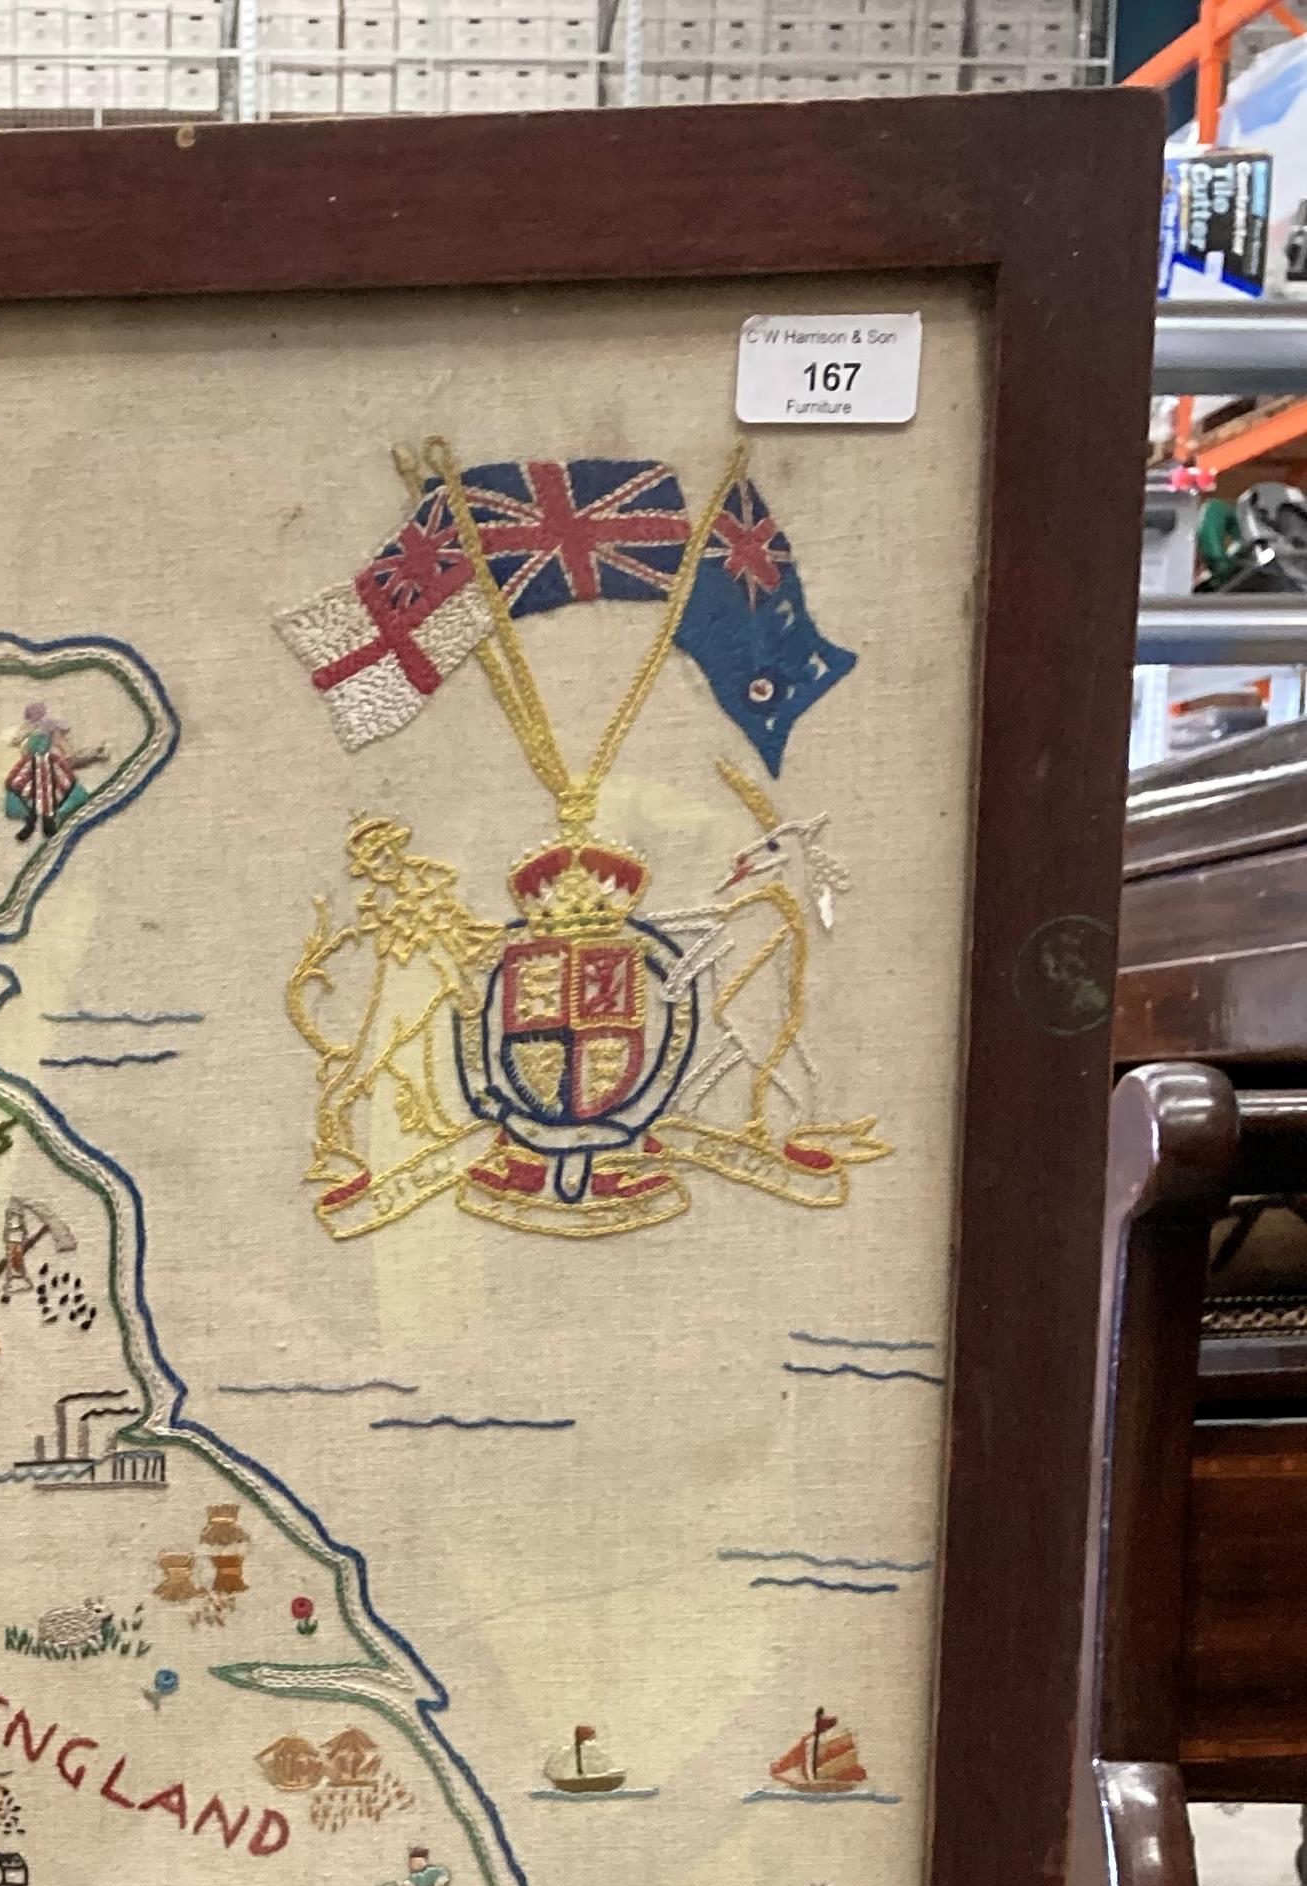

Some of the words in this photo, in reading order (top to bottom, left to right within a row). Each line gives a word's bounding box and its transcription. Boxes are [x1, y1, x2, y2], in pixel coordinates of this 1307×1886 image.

[1211, 163, 1234, 215] Tile
[1189, 163, 1213, 251] Cutter
[746, 329, 758, 344] C
[764, 329, 780, 344] W
[784, 329, 846, 344] Harrison
[851, 329, 862, 344] &
[867, 329, 898, 344] Son
[803, 361, 862, 392] 167
[785, 399, 853, 414] Furniture
